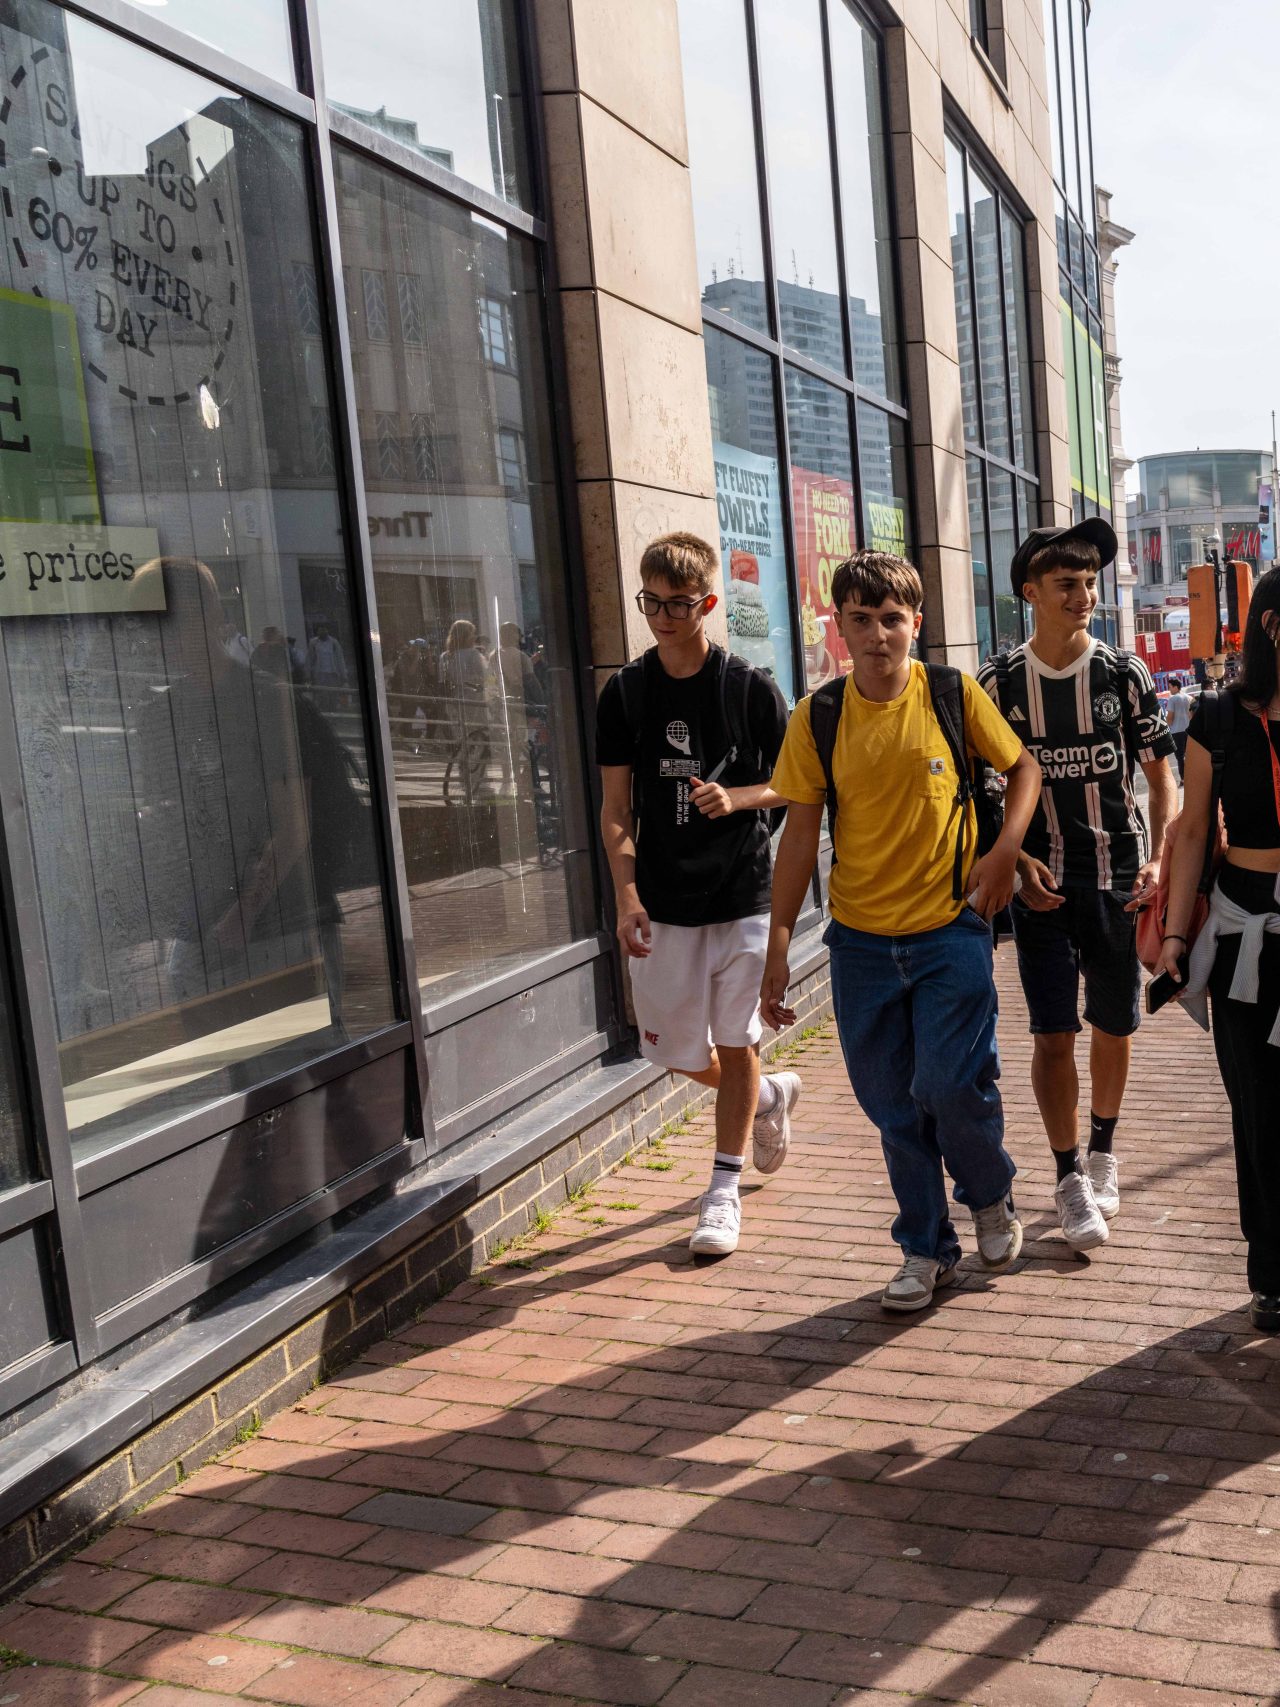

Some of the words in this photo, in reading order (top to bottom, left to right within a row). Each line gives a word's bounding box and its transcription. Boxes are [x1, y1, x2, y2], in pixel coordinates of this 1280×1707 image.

[76, 160, 120, 216] UP
[136, 198, 176, 253] TO
[28, 196, 99, 272] 60%
[110, 239, 212, 331] EVERY
[94, 289, 158, 358] DAY
[730, 465, 769, 499] FLUFFY
[812, 488, 823, 510] NO
[823, 491, 839, 513] NEED
[839, 495, 850, 515] TO
[814, 512, 851, 556] FORK
[24, 543, 136, 591] prices
[1027, 744, 1090, 765] Team
[676, 801, 683, 812] MY
[683, 815, 689, 823] IN
